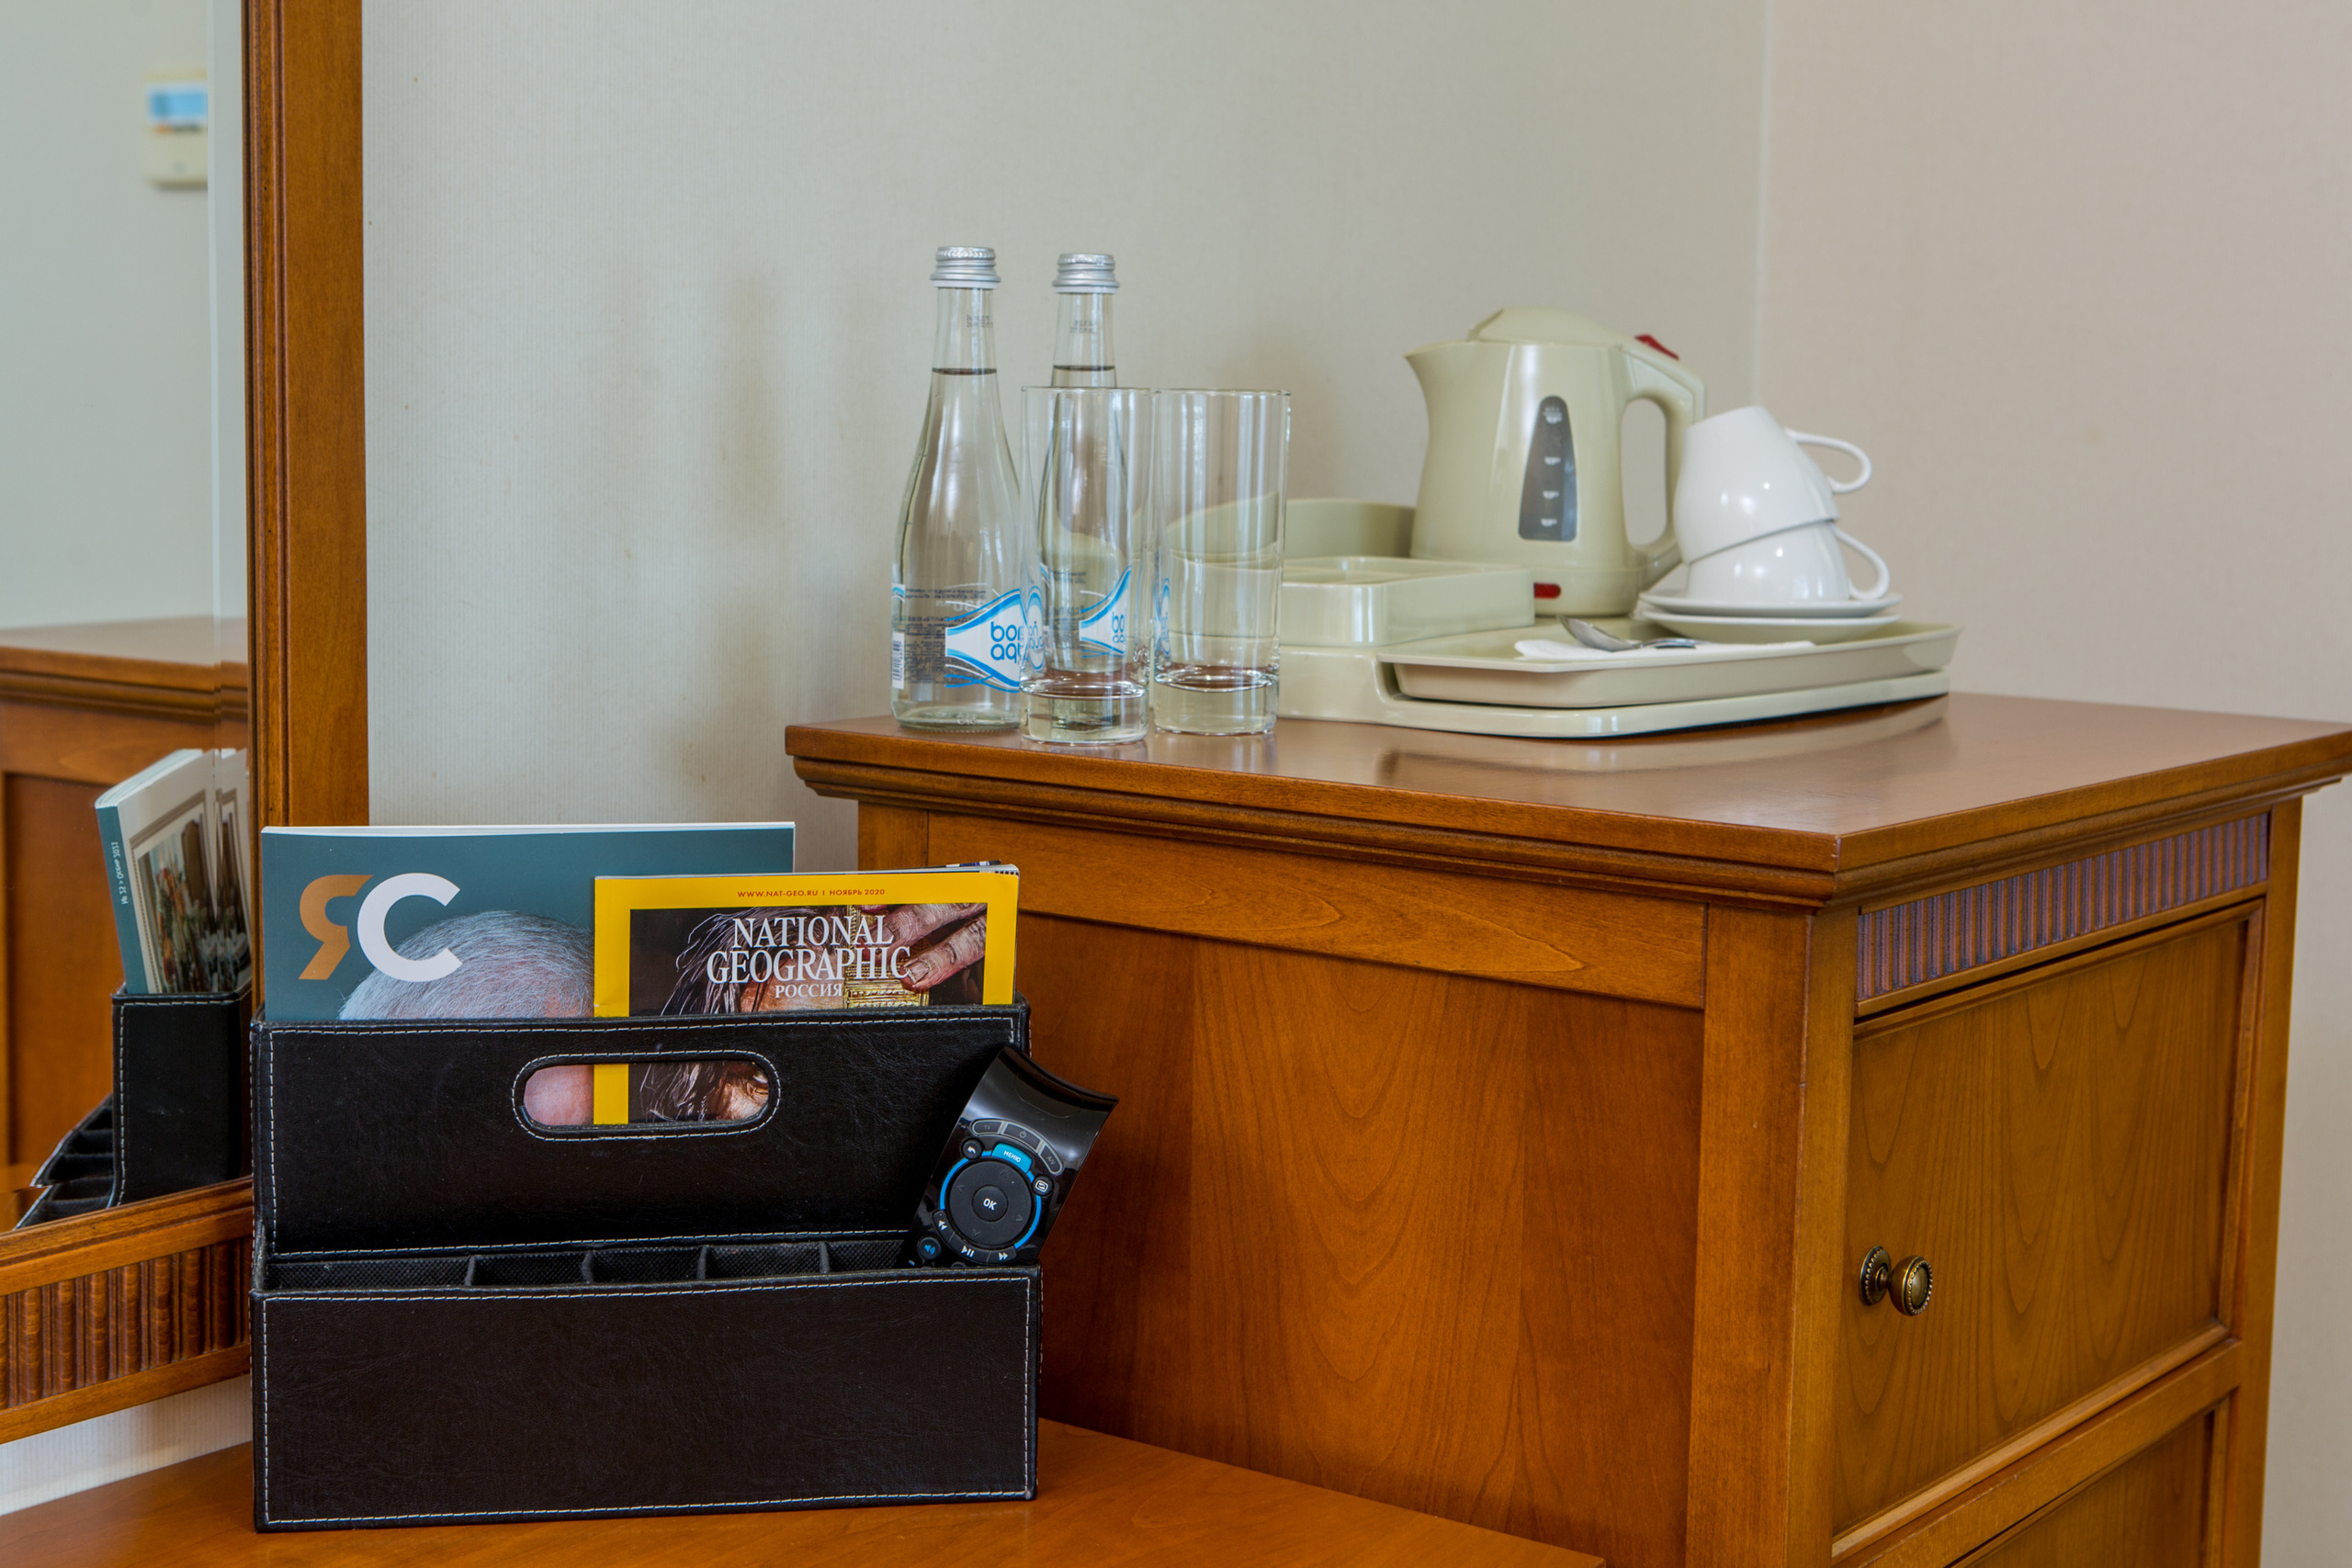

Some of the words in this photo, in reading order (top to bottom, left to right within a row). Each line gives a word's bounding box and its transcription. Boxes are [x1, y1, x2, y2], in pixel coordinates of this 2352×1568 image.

[737, 889, 818, 897] WWW.NAT-GEO.RU
[829, 888, 863, 897] НОЯБРЬ
[732, 914, 894, 949] NATIONAL
[707, 946, 911, 984] GEOGRAPHIC
[775, 983, 843, 999] РОССИЯ
[1003, 1150, 1021, 1162] МЕНЮ
[983, 1199, 997, 1210] OK
